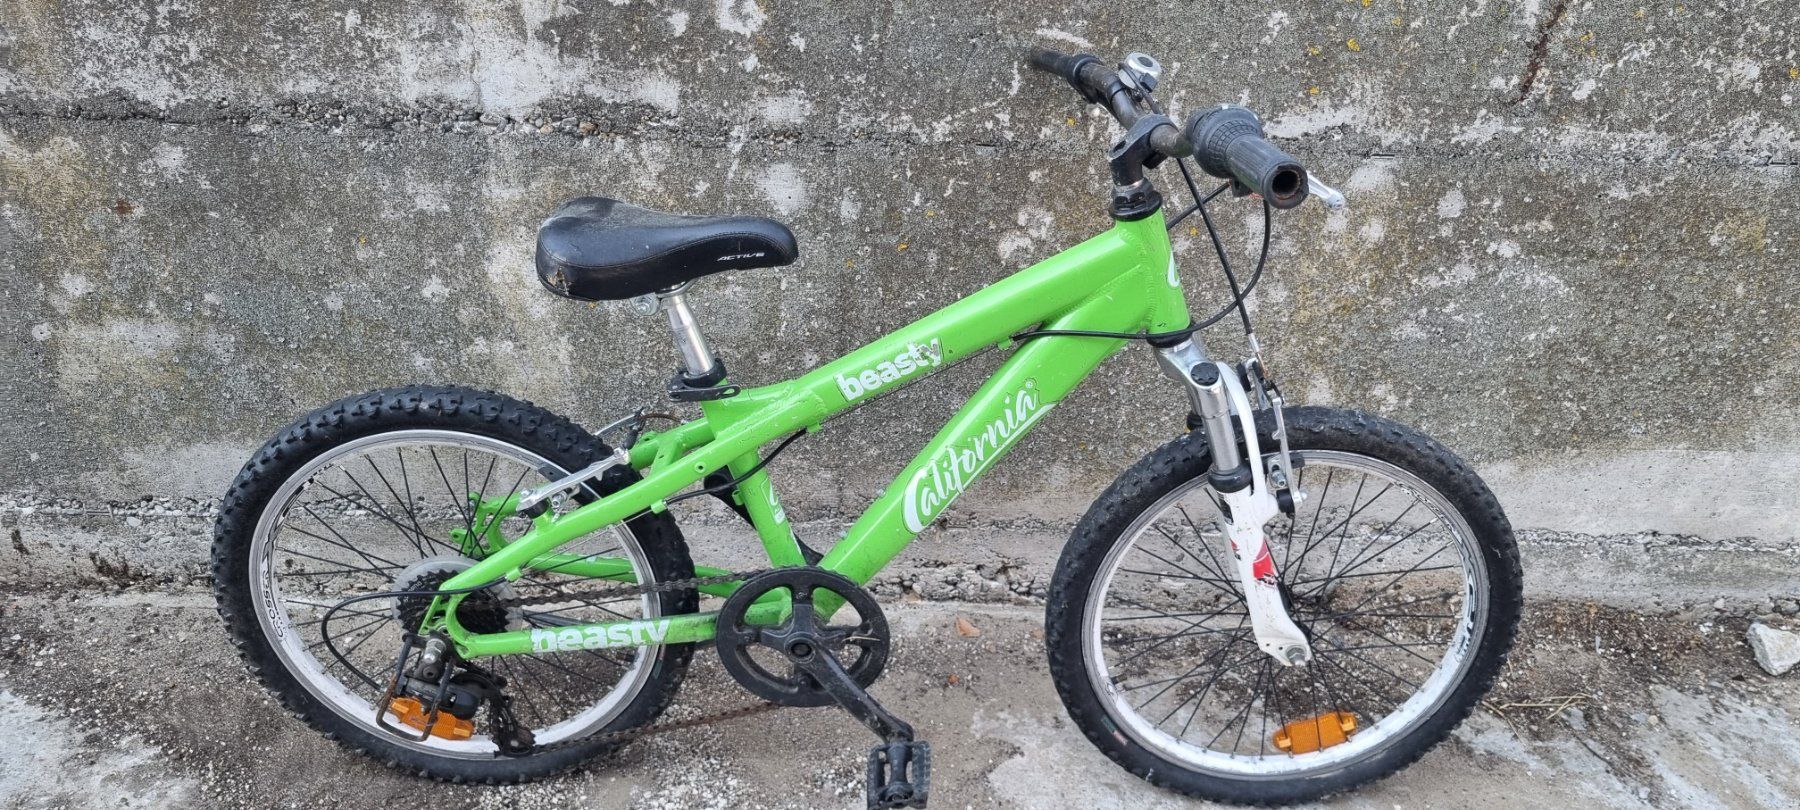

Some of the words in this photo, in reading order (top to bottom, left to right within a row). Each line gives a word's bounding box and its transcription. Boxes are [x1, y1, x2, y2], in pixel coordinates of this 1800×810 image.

[716, 252, 765, 262] ACTIVE
[835, 337, 943, 401] beasty
[903, 380, 1042, 533] California
